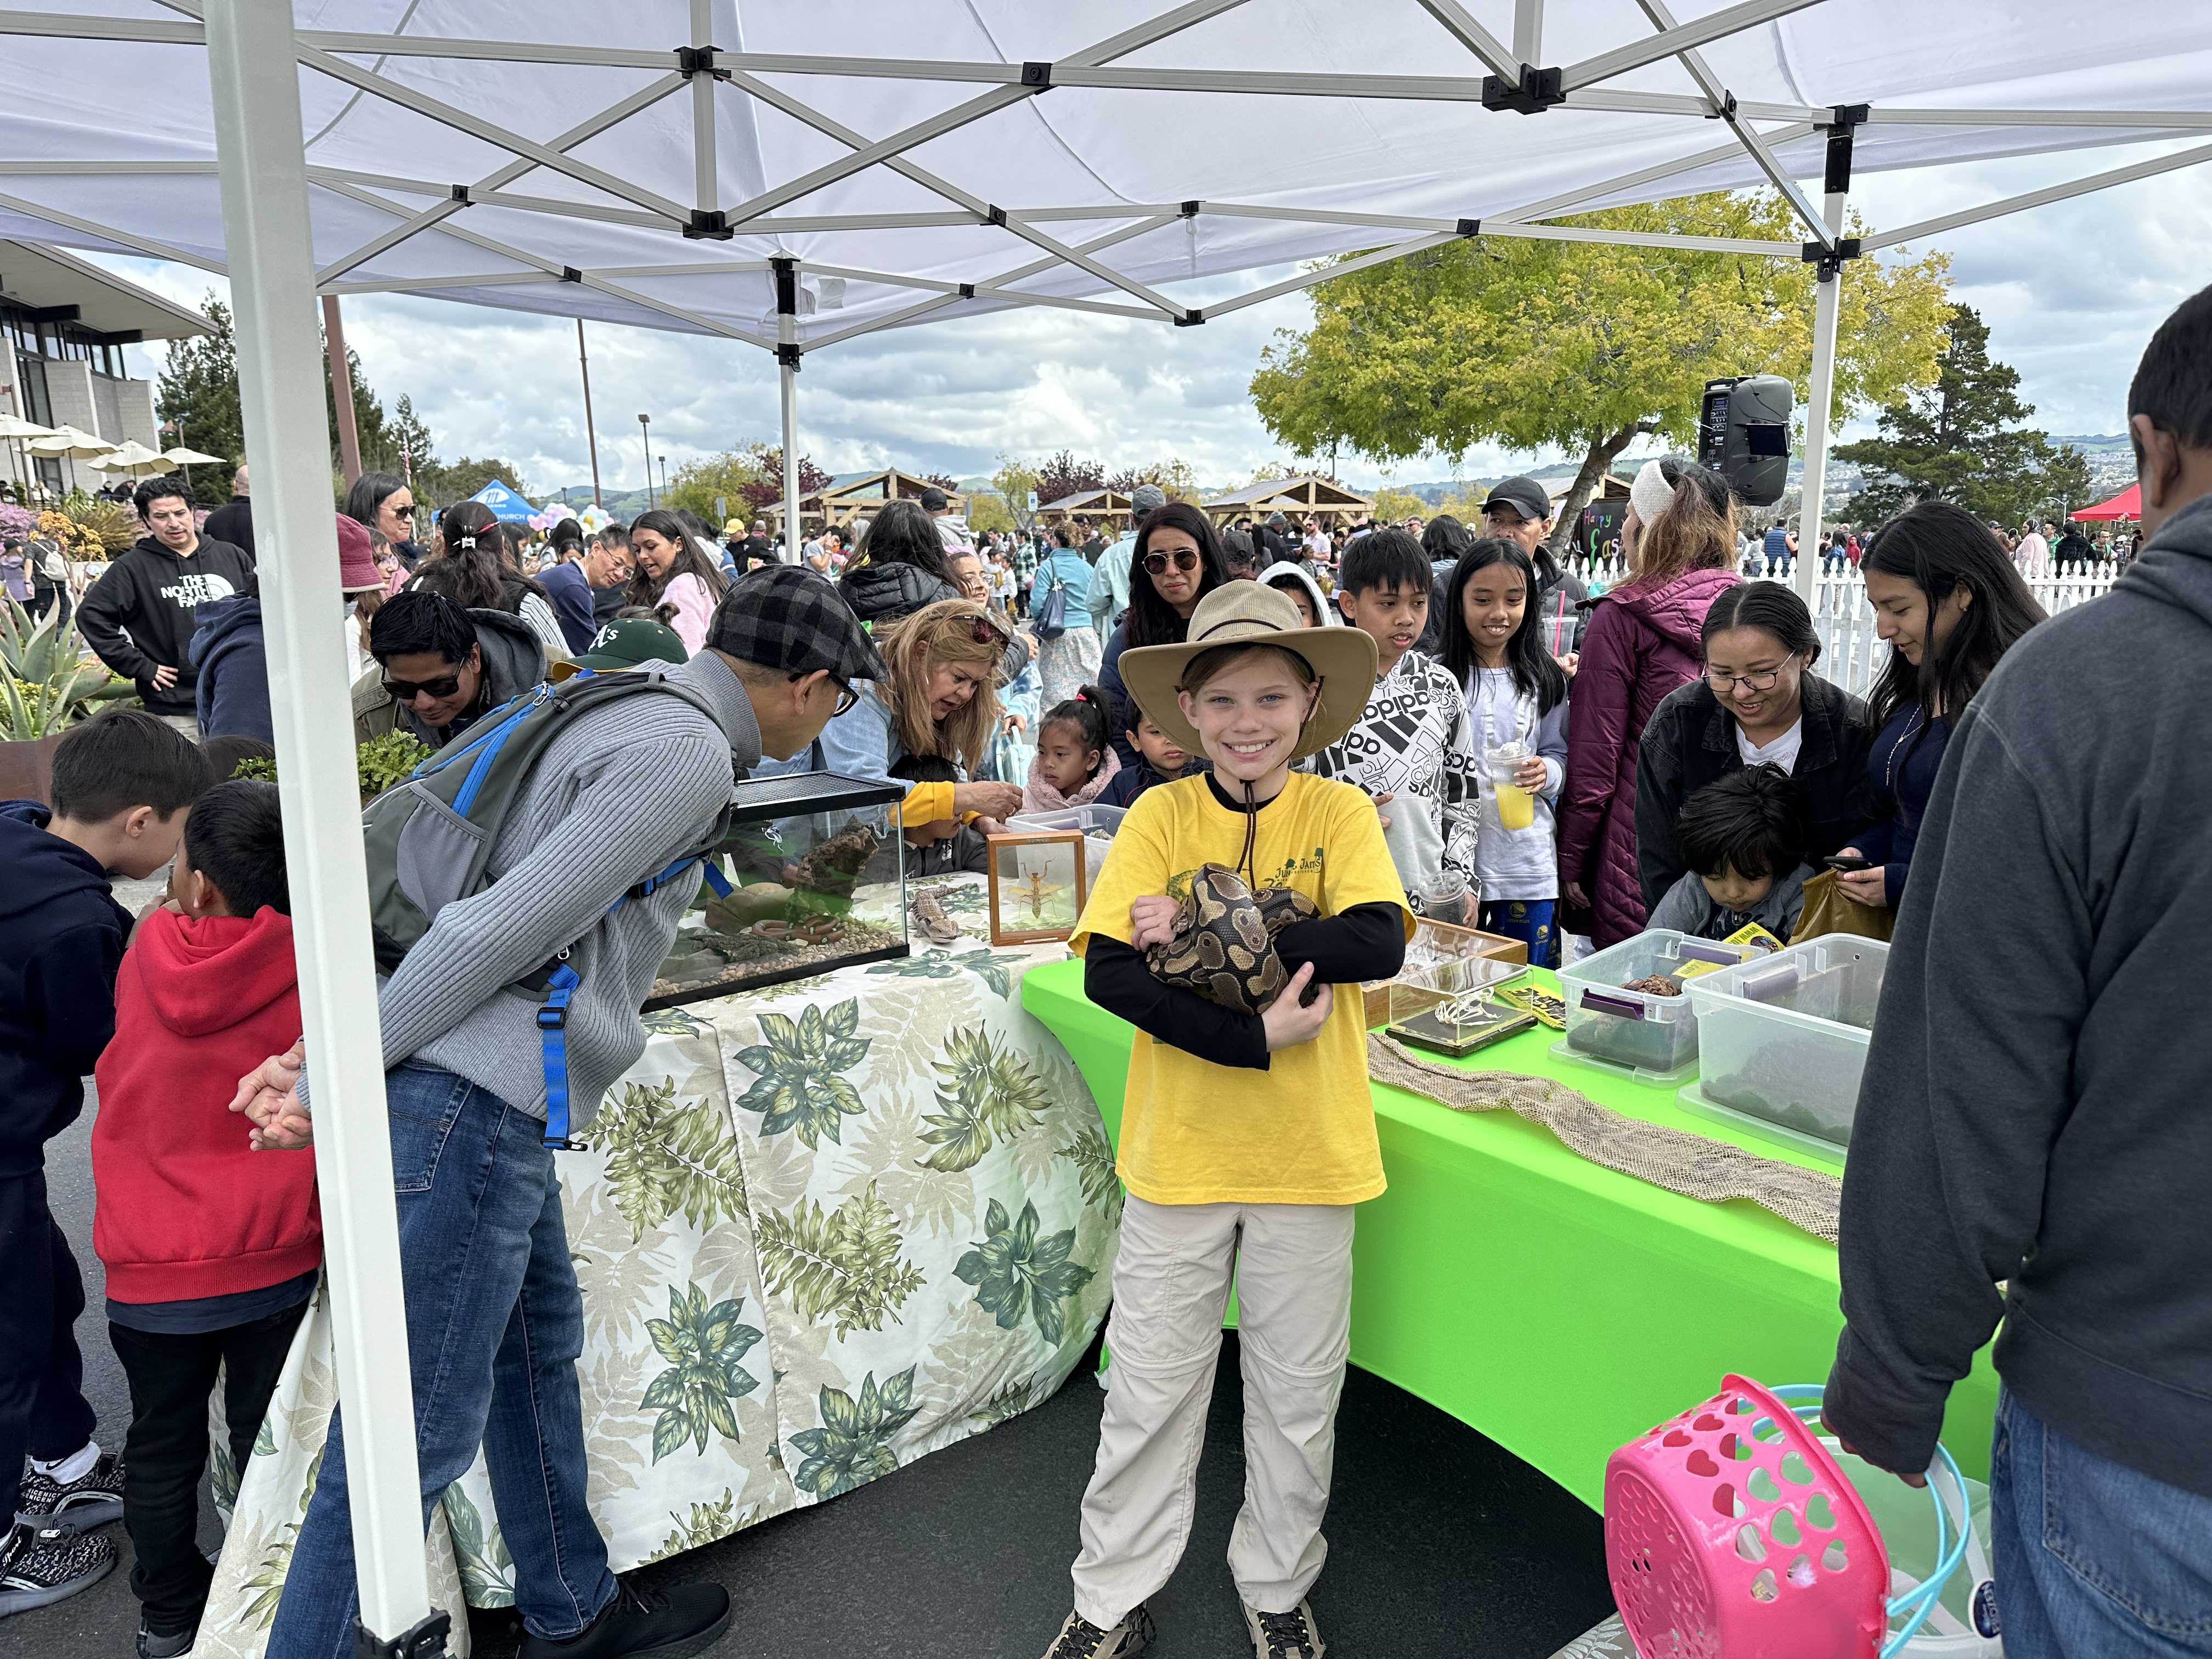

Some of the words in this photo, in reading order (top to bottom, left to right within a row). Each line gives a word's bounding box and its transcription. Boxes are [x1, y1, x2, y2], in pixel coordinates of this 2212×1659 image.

[1584, 510, 1612, 529] Happy
[178, 574, 205, 586] THE
[588, 624, 619, 652] A's
[2, 1536, 22, 1567] Sport
